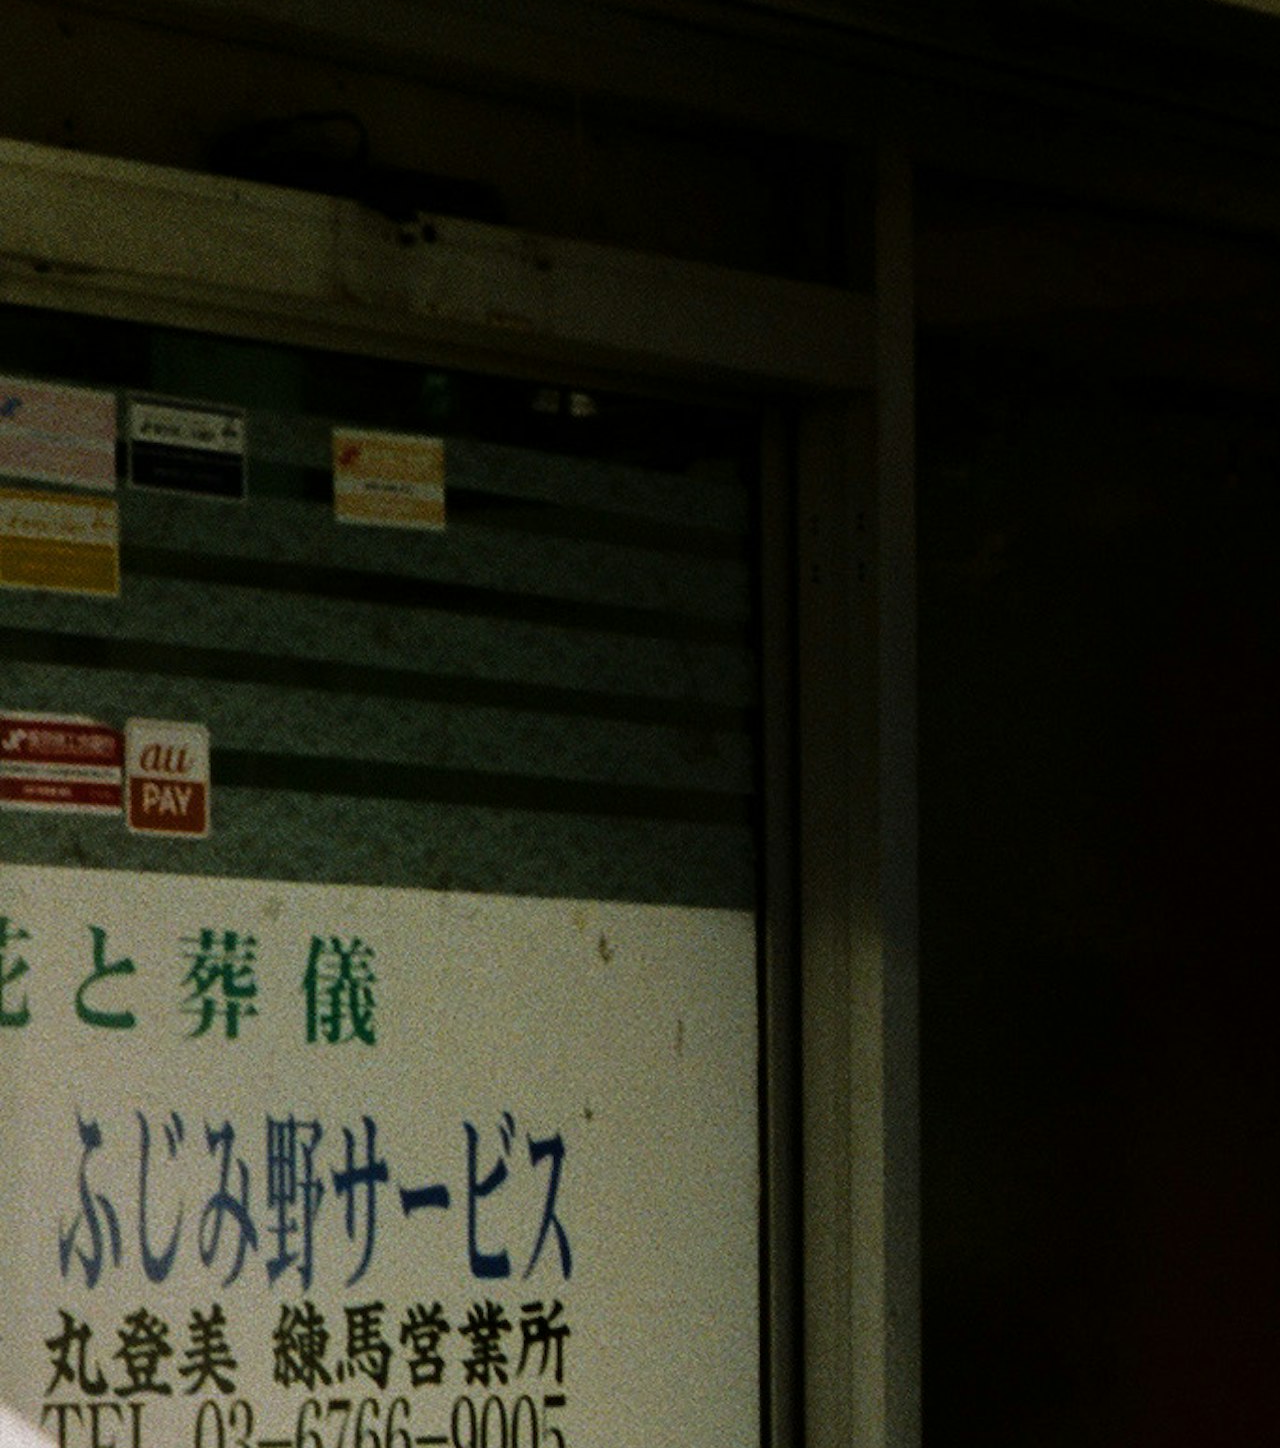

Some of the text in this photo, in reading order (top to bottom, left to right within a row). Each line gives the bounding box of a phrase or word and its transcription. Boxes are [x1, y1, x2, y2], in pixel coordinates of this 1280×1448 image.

[140, 742, 194, 775] au
[141, 783, 194, 817] PAY
[58, 1108, 574, 1291] ふじみ野サービス
[272, 1299, 572, 1389] 練馬営業所
